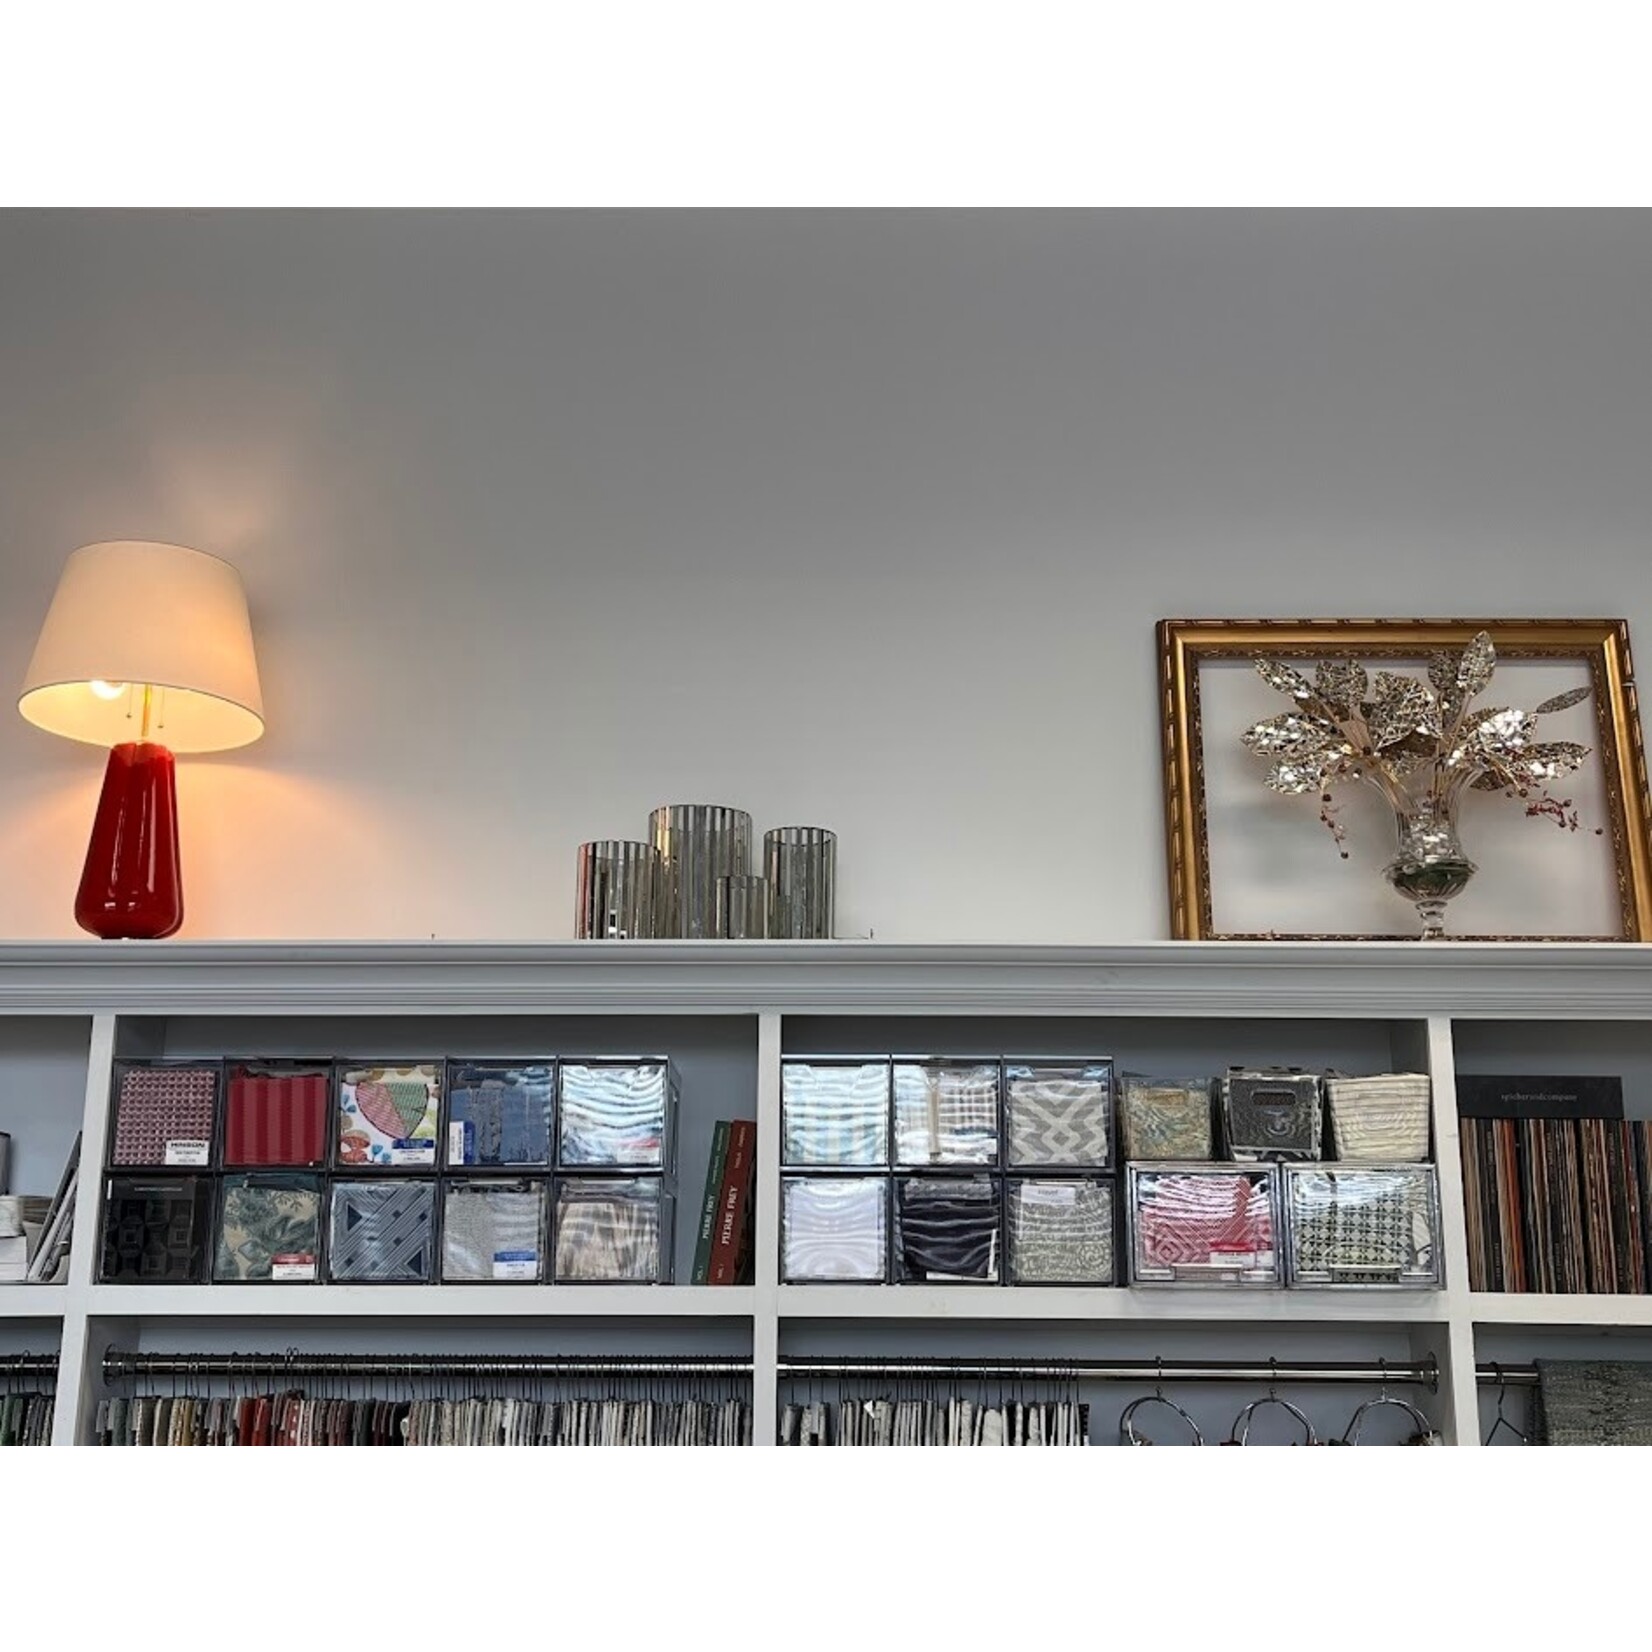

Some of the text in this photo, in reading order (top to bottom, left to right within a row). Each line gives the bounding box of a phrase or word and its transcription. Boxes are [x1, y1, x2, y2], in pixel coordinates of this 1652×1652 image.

[703, 1195, 715, 1239] PIERRE FREY
[721, 1185, 739, 1245] PIERRE FREY
